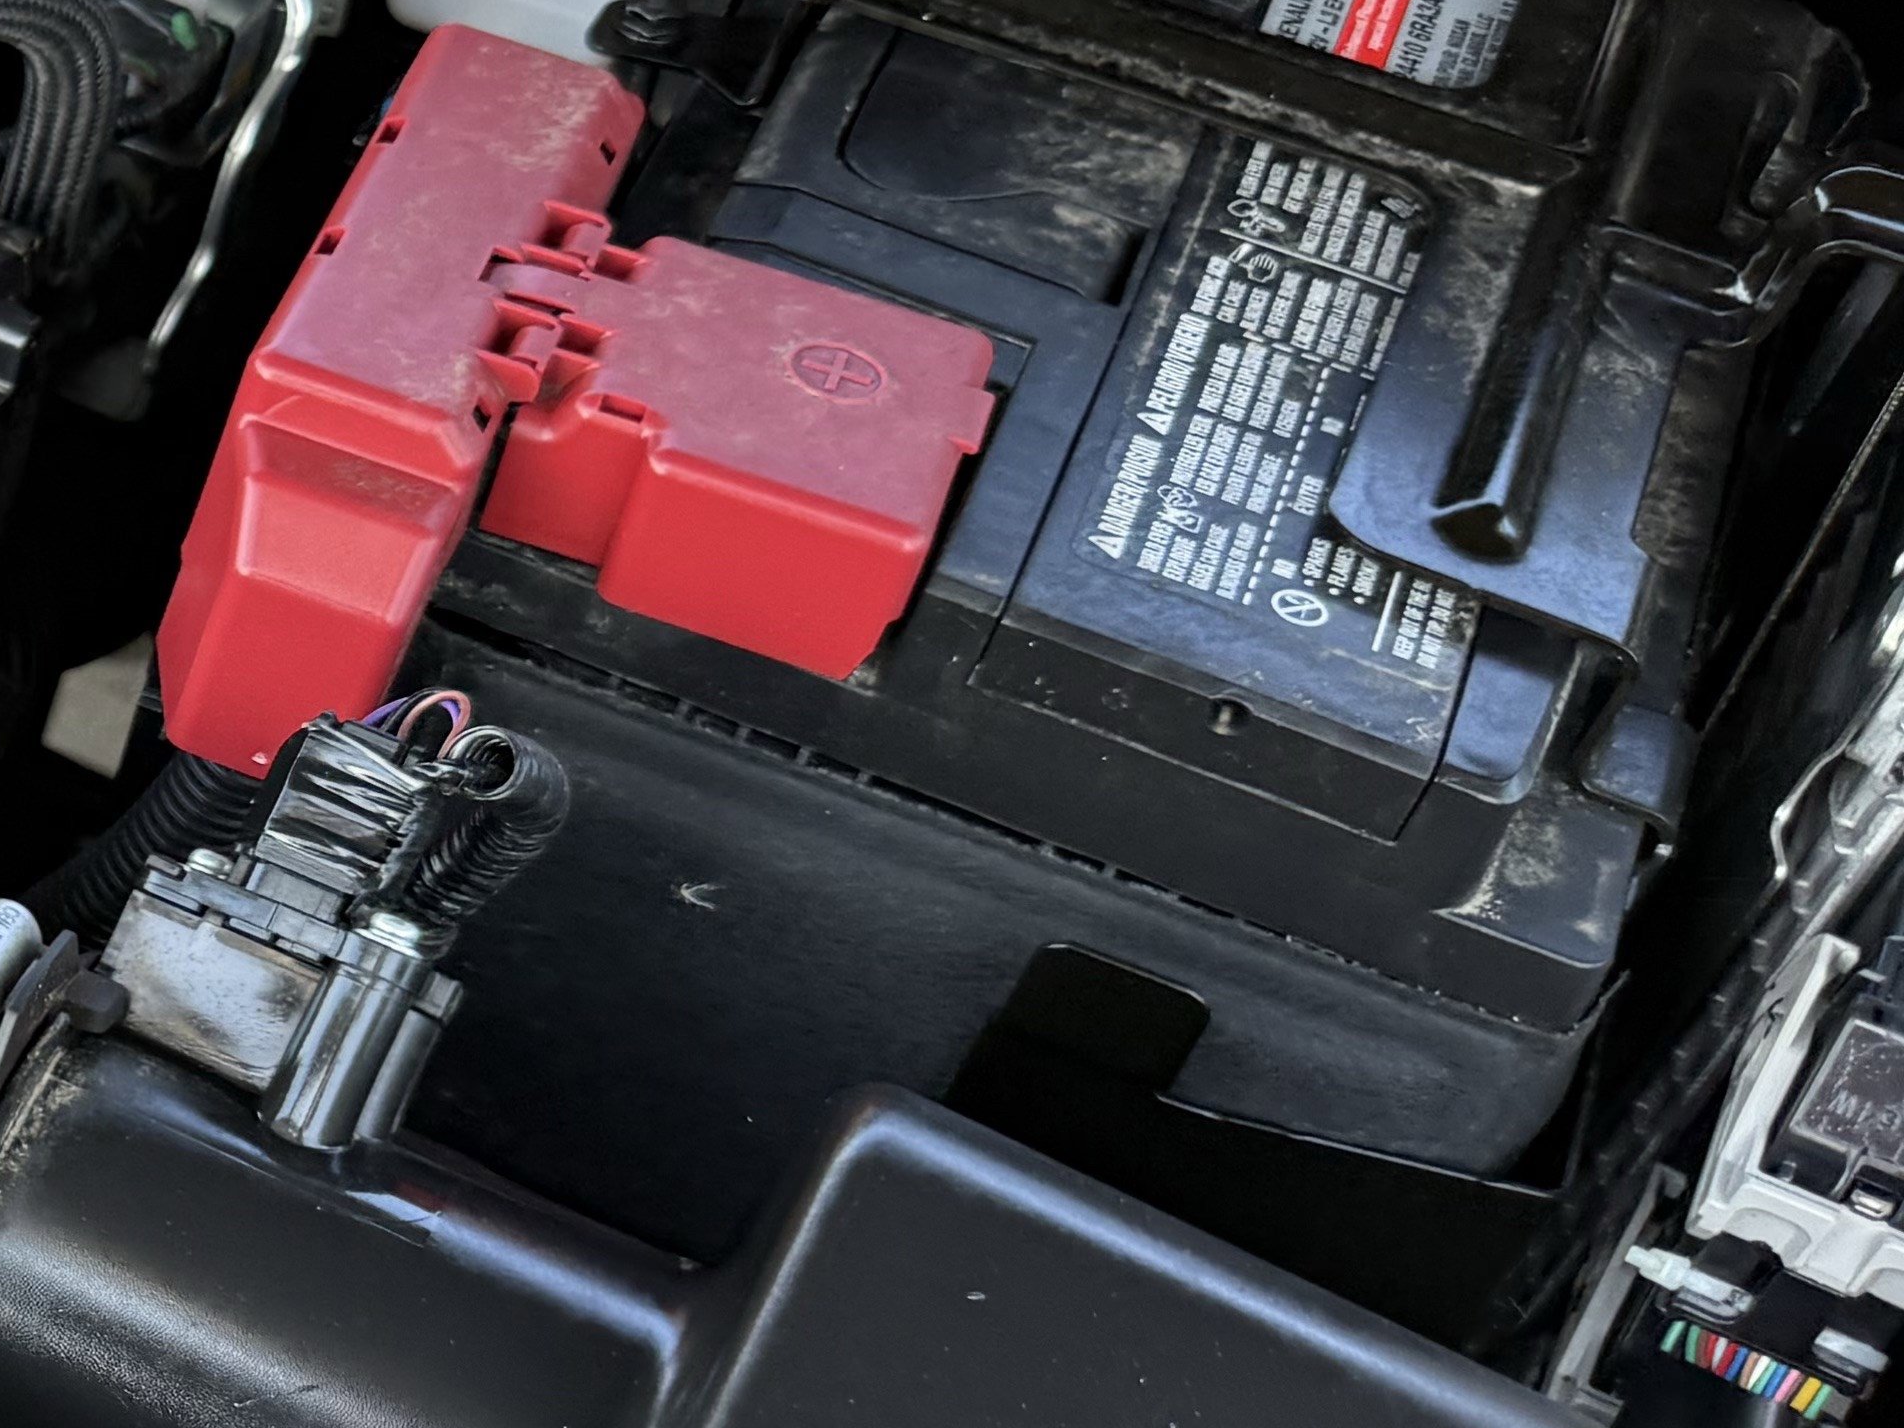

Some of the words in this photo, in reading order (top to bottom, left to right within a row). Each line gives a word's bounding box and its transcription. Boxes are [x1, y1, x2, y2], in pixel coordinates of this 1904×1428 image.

[1147, 314, 1208, 414] PELIGRO/VENENO
[1099, 435, 1160, 536] DANGER/POISON
[1287, 474, 1323, 515] ÉVITER
[1302, 536, 1333, 580] SPARKS
